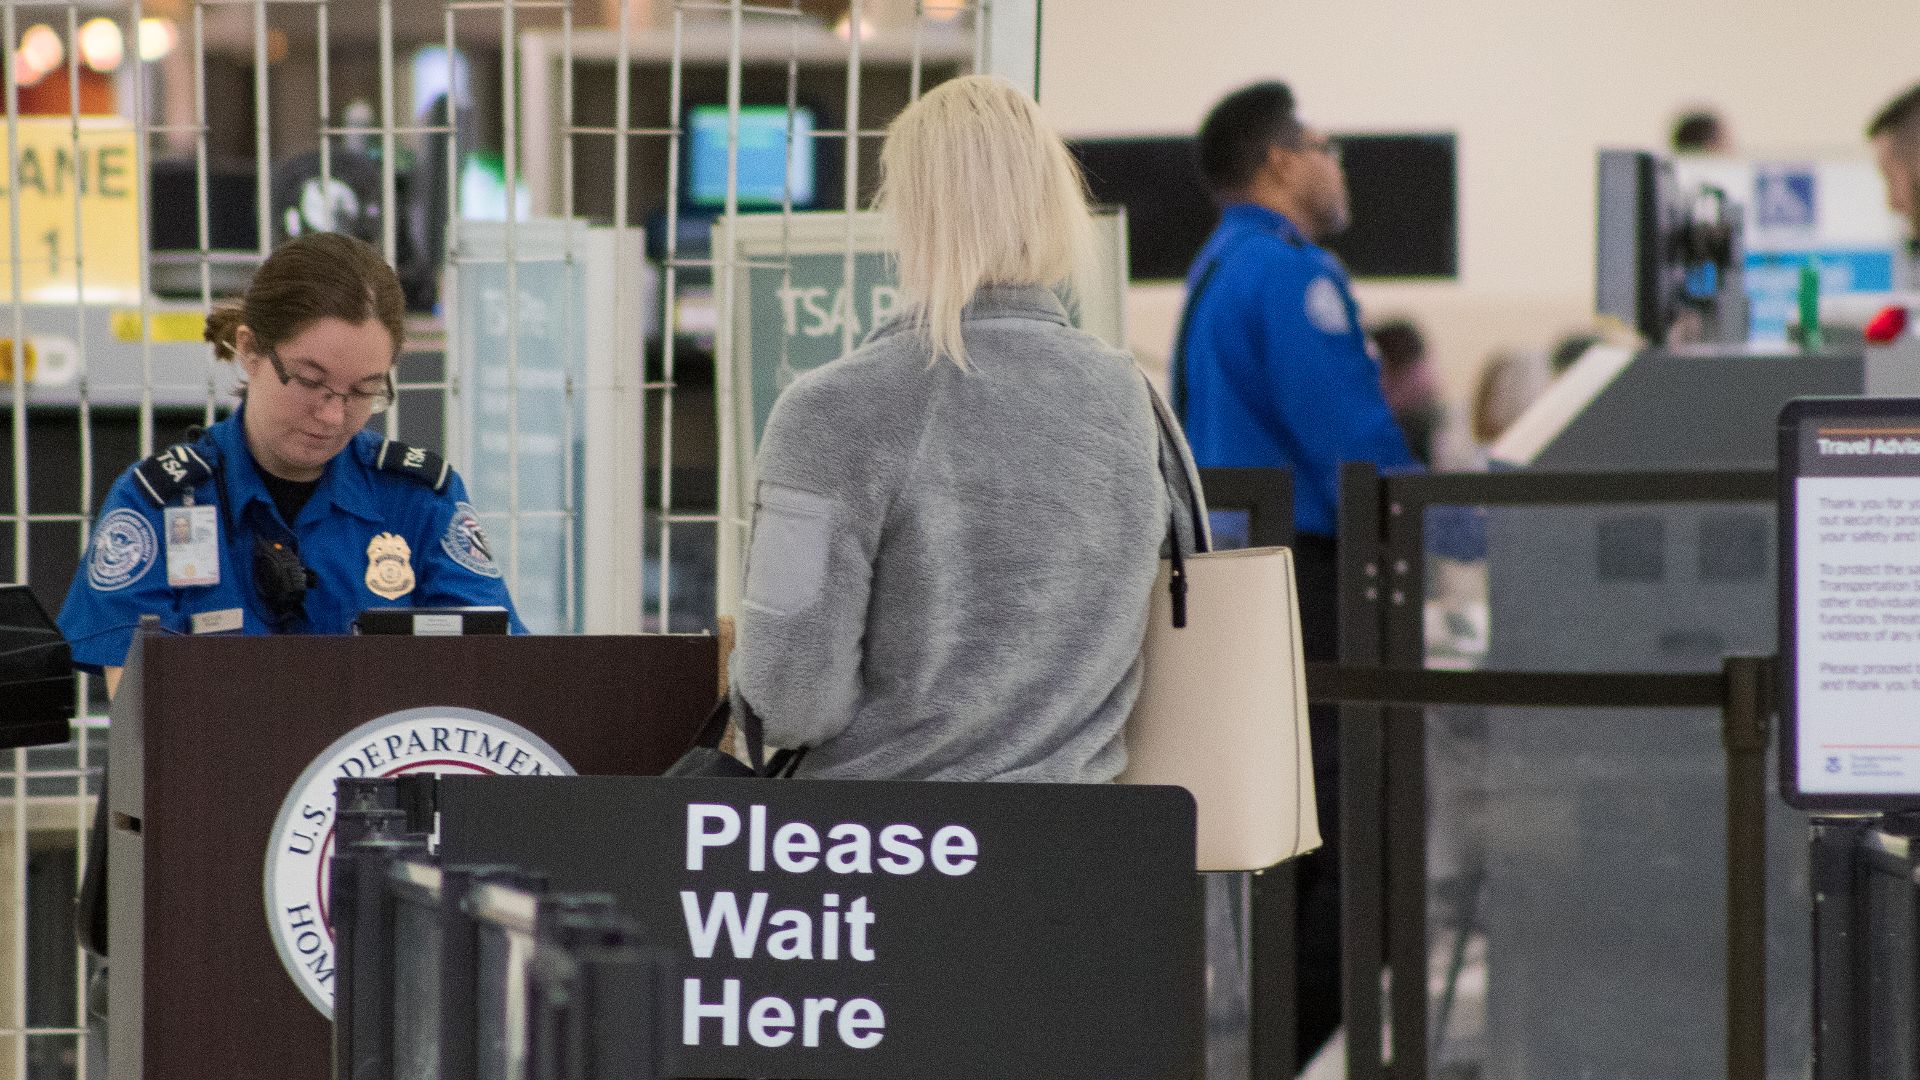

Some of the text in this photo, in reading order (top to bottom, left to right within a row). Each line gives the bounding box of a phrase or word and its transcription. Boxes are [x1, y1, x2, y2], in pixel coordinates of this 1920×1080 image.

[0, 145, 129, 197] ANE
[42, 228, 60, 278] 1
[777, 286, 861, 336] TSA
[1818, 438, 1870, 455] Travel
[156, 449, 188, 482] TSA
[1820, 497, 1855, 508] Thank
[1861, 499, 1882, 510] you
[1886, 497, 1903, 508] for
[1843, 515, 1891, 526] security
[1821, 531, 1916, 543] your safety and
[1820, 563, 1834, 575] To
[1837, 564, 1881, 576] protect
[1884, 564, 1904, 575] the
[1820, 580, 1910, 592] Transportation
[1820, 597, 1850, 608] other
[1821, 630, 1871, 641] violence
[1820, 662, 1858, 674] Please
[1863, 663, 1912, 675] proceed
[1820, 680, 1843, 690] and
[1846, 679, 1880, 690] thank
[1886, 681, 1908, 692] you
[288, 727, 553, 857] U.S. DEPARTME
[686, 803, 979, 876] Please
[679, 890, 876, 962] Wait
[287, 901, 334, 996] HOM
[682, 977, 886, 1049] Here
